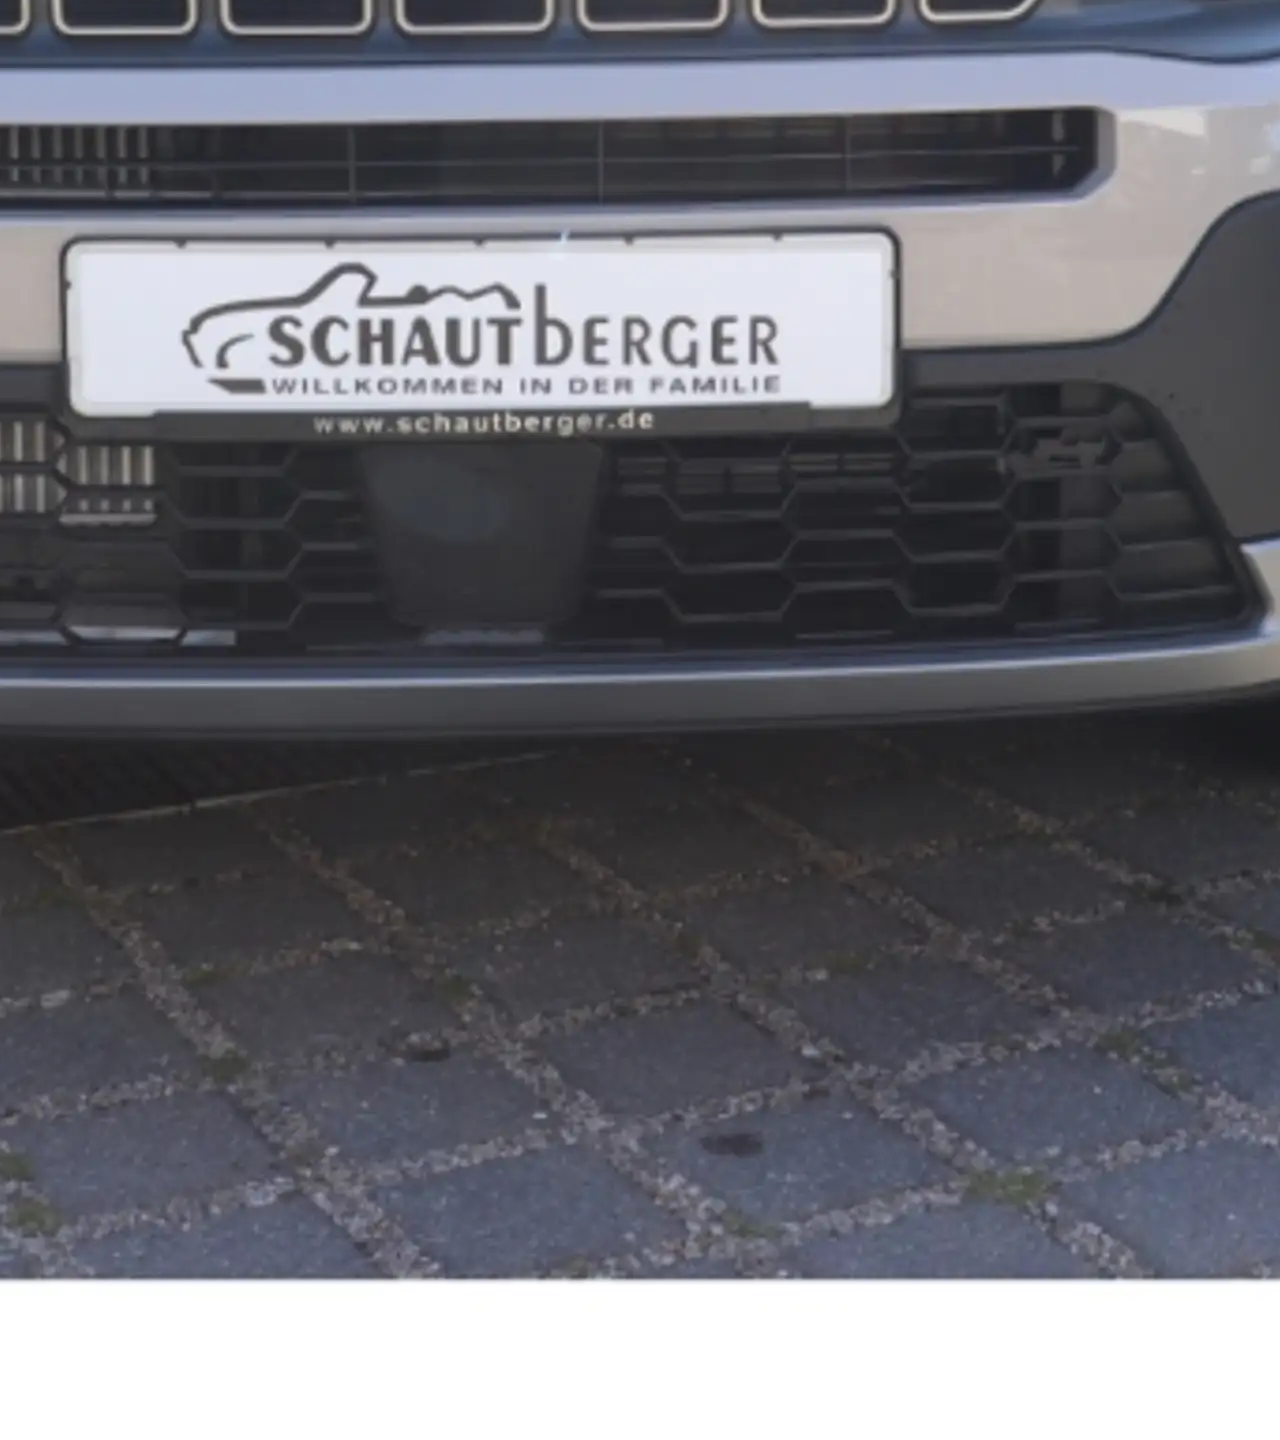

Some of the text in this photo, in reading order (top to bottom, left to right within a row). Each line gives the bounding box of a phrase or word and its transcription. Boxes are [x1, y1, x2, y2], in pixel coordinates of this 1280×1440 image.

[271, 375, 781, 395] WILLKOMMEN IN DER FAMILIE
[313, 410, 655, 437] www.schautberger.de
